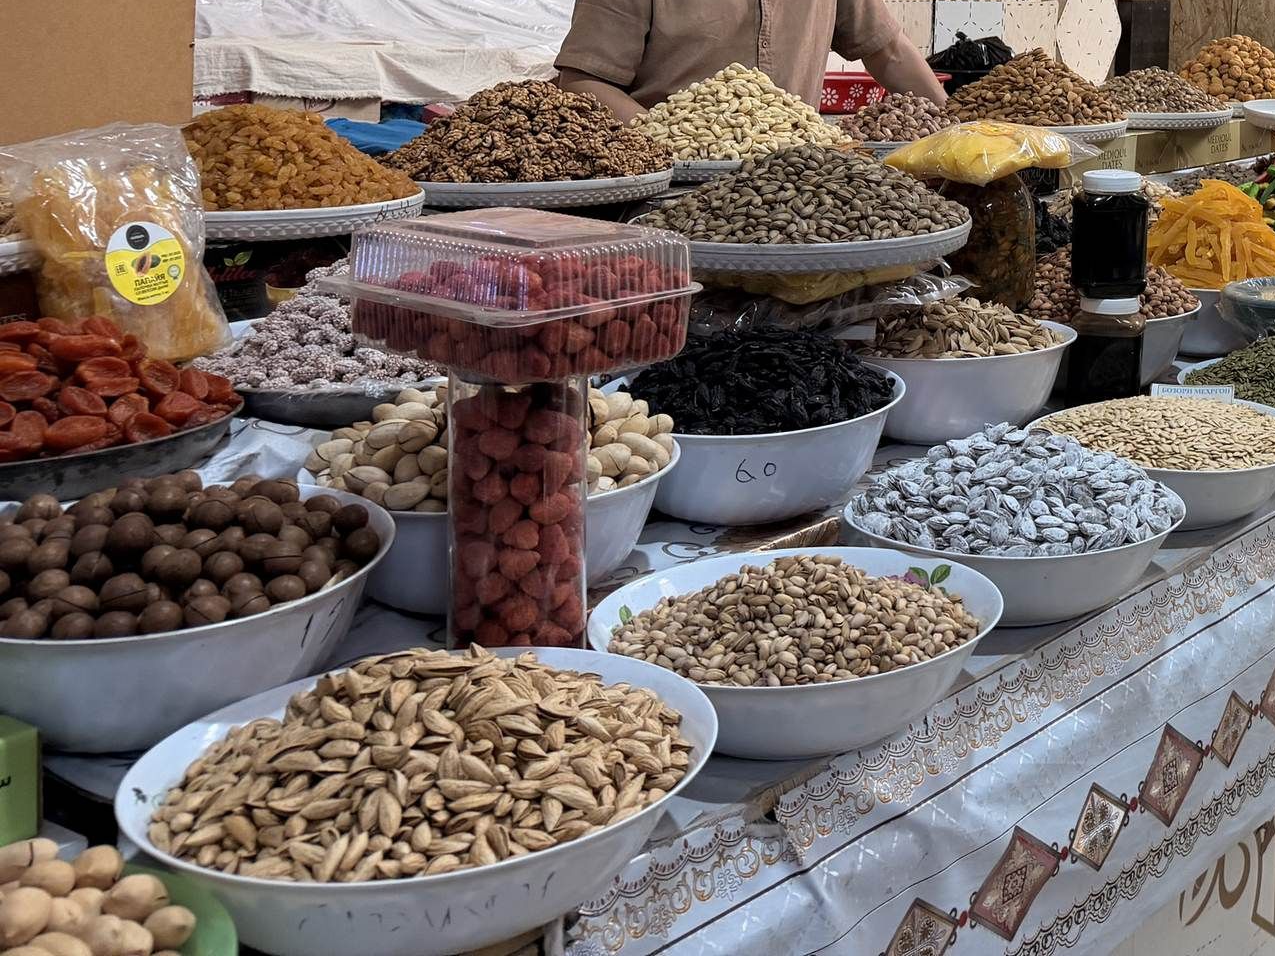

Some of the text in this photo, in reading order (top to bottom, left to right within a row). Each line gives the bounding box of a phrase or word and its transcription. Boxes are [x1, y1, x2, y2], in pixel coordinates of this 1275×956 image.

[1210, 143, 1229, 154] DATES
[1102, 159, 1123, 170] DATES
[735, 458, 777, 483] 60
